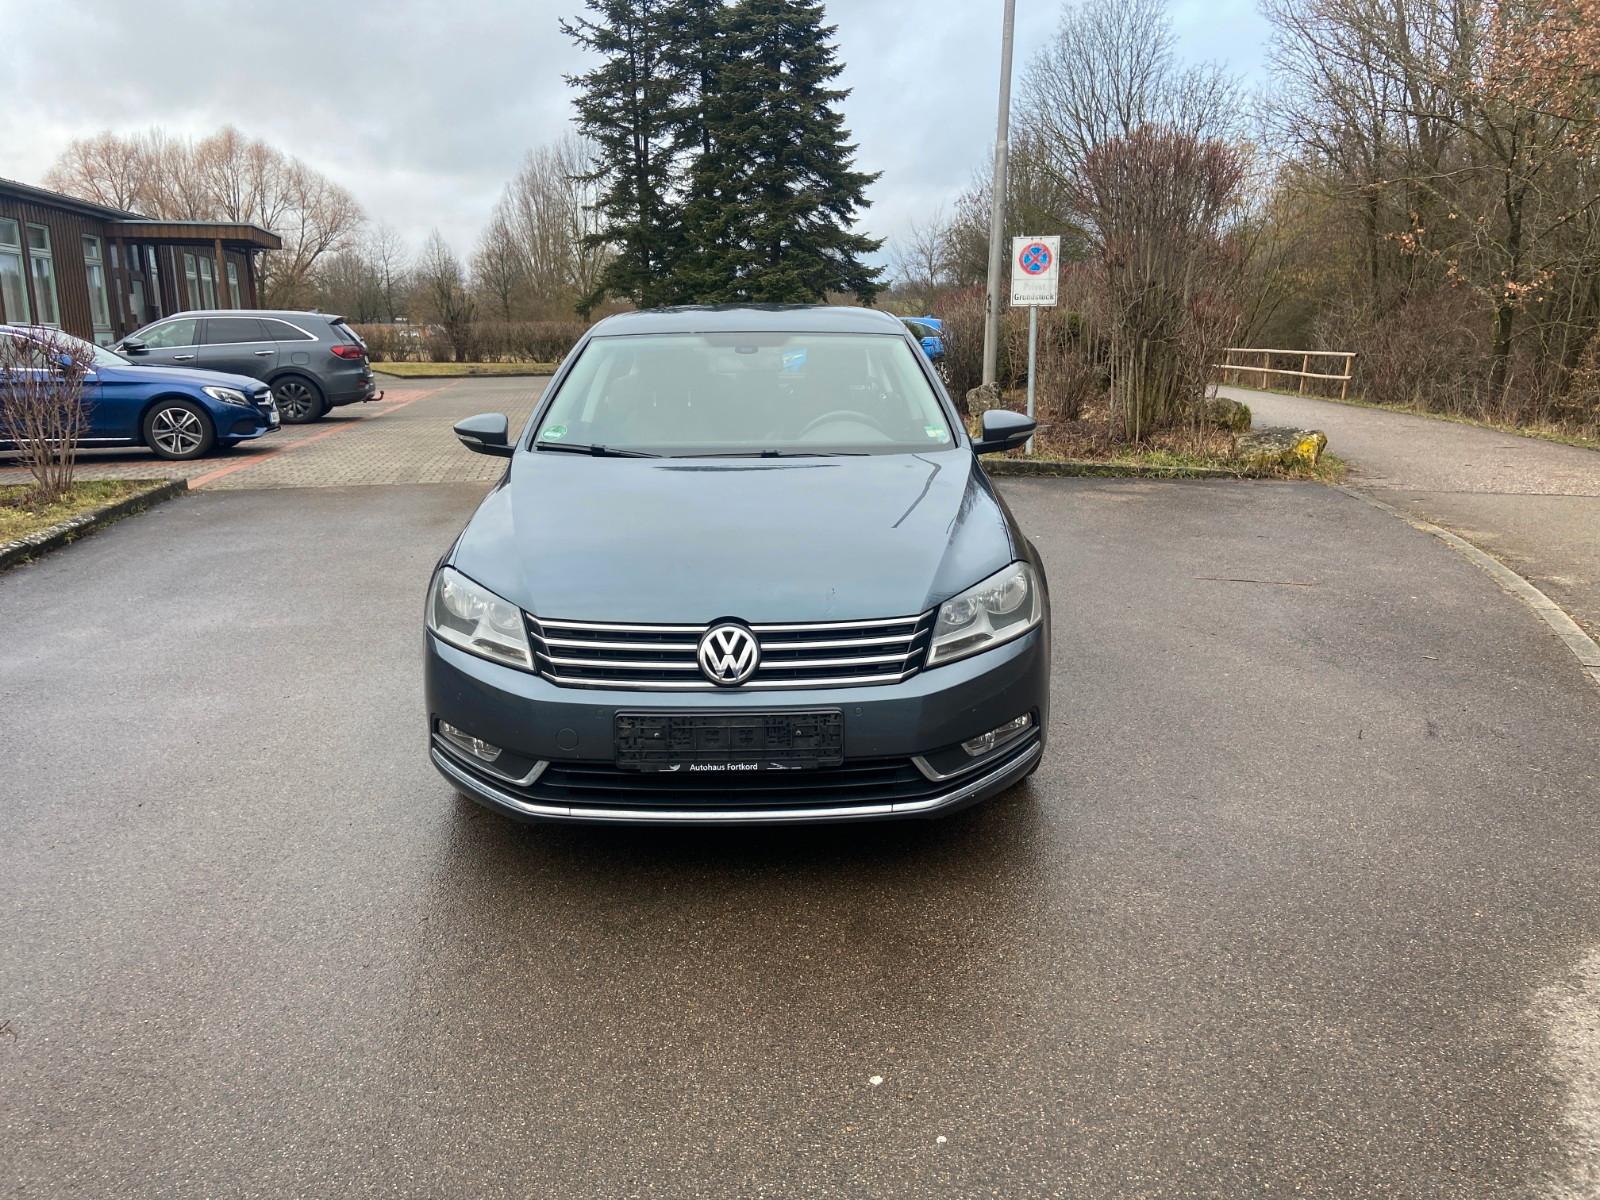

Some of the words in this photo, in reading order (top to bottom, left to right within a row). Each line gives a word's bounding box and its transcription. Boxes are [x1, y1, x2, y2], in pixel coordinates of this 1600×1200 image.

[701, 627, 757, 681] VW
[689, 764, 725, 772] Autohaus
[727, 762, 758, 771] Fortkord
